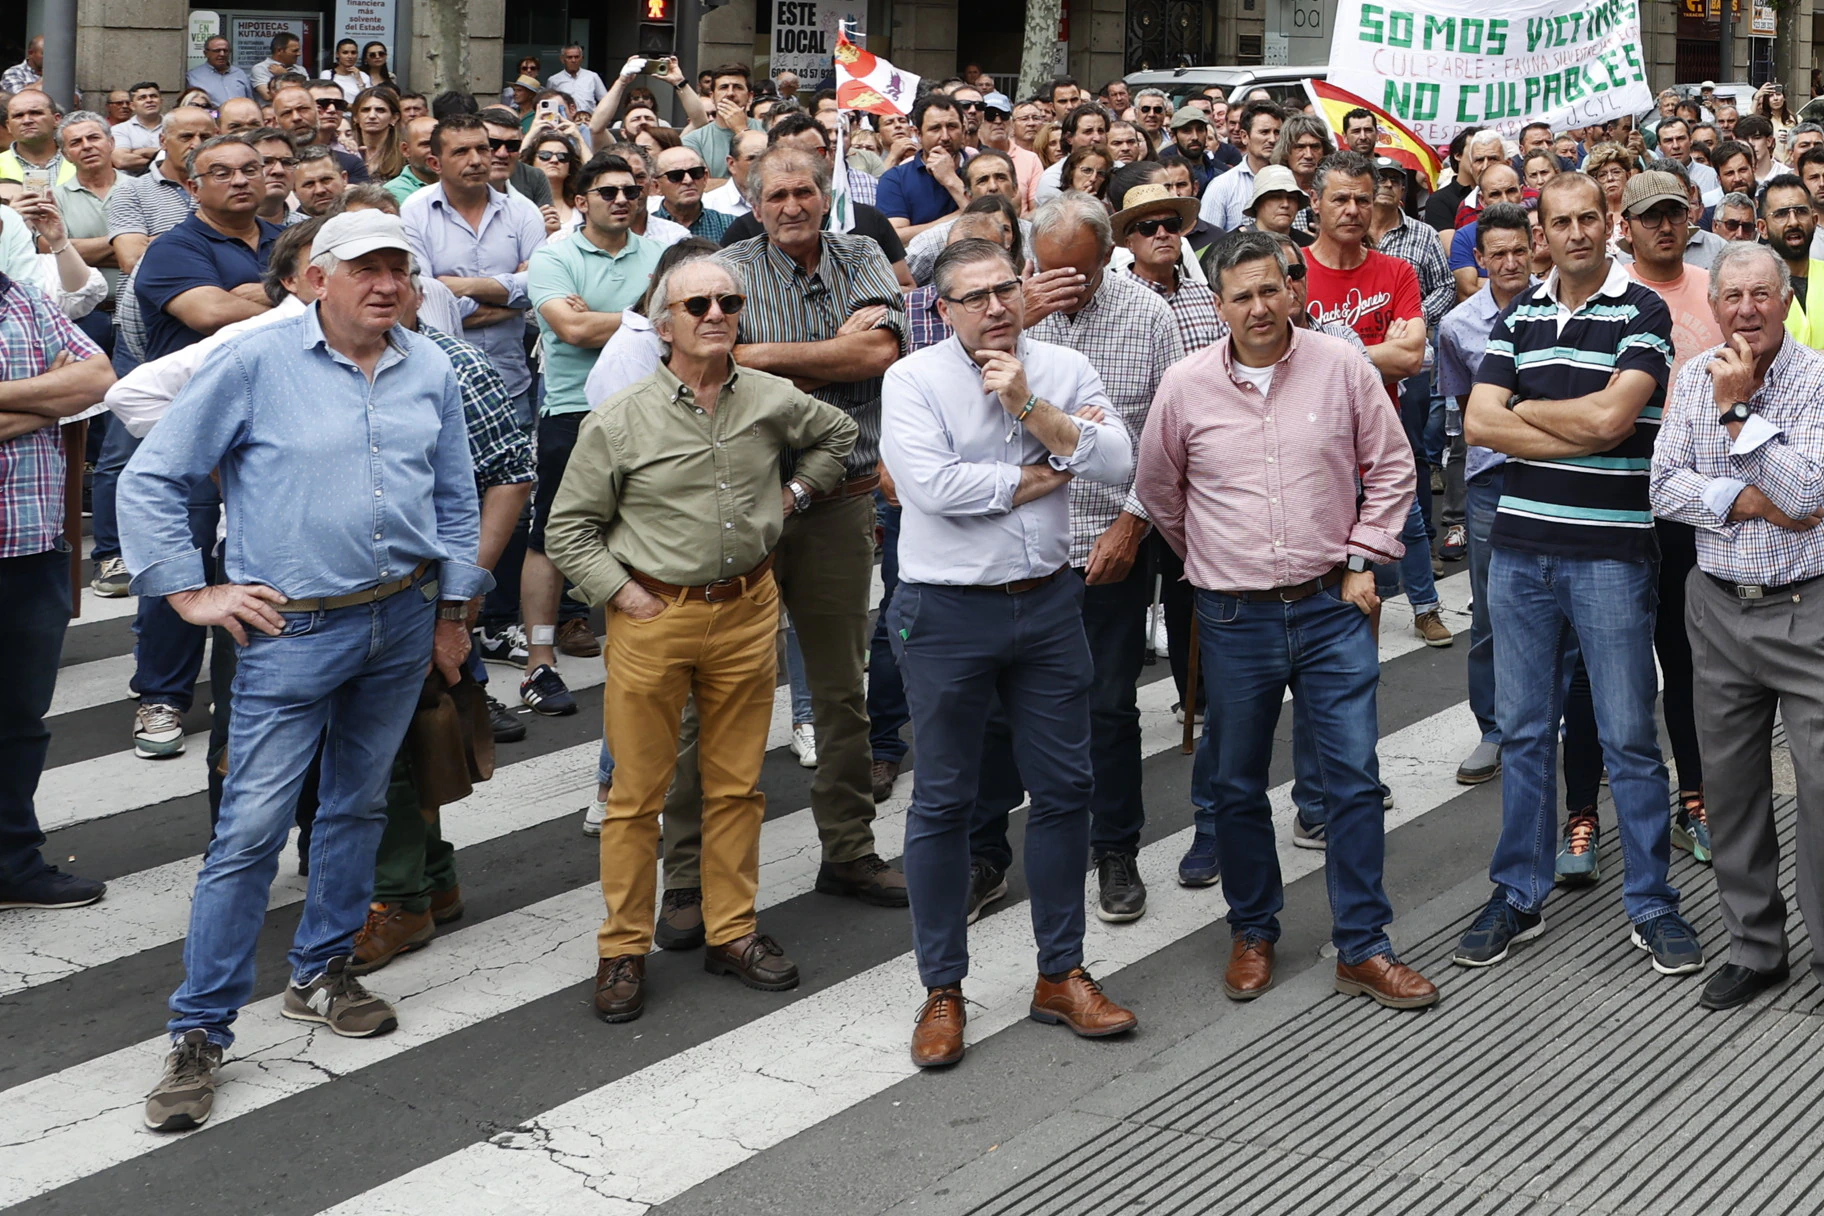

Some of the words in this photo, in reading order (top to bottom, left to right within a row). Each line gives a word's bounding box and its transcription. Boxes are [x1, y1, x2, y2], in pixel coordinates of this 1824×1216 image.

[346, 0, 386, 8] financiera
[777, 1, 817, 26] ESTE
[1293, 1, 1320, 28] ba
[238, 21, 289, 31] HIPOTECAS
[344, 23, 358, 31] del
[358, 24, 385, 32] Estado
[349, 15, 382, 23] solvente
[1358, 3, 1509, 56] SOMOS
[776, 29, 827, 54] LOCAL
[1383, 78, 1441, 122] NO
[1456, 42, 1645, 123] CULPABLES
[1306, 300, 1341, 327] Jack
[1345, 287, 1391, 328] Jones
